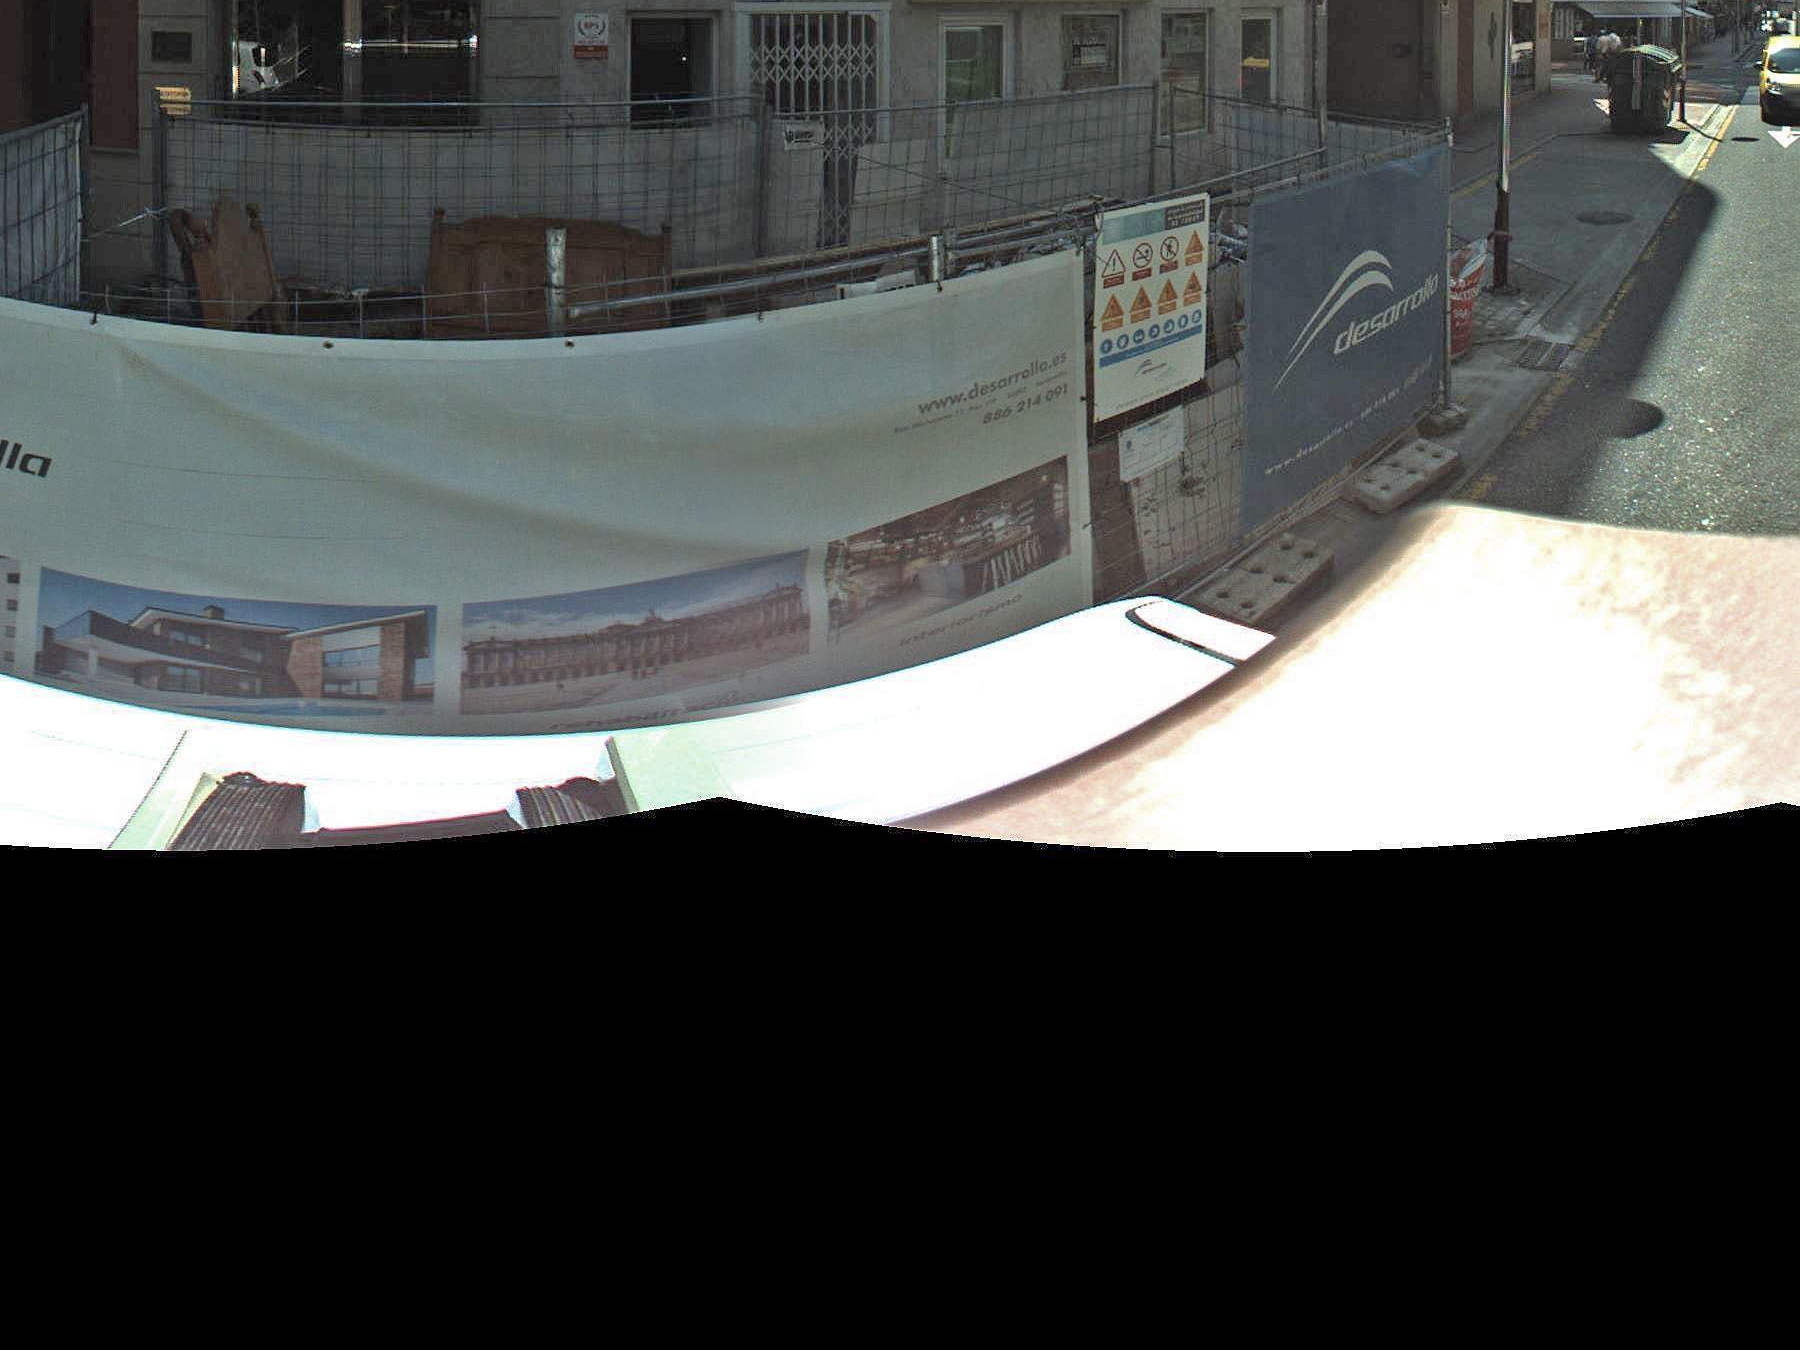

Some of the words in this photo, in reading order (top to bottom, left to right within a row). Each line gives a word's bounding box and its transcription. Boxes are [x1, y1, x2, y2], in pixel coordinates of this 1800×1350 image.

[1333, 273, 1440, 355] desarrolla
[917, 351, 1069, 414] www.desarrolla.es
[983, 408, 1012, 425] 886
[1016, 394, 1041, 414] 214
[1045, 382, 1069, 403] 091
